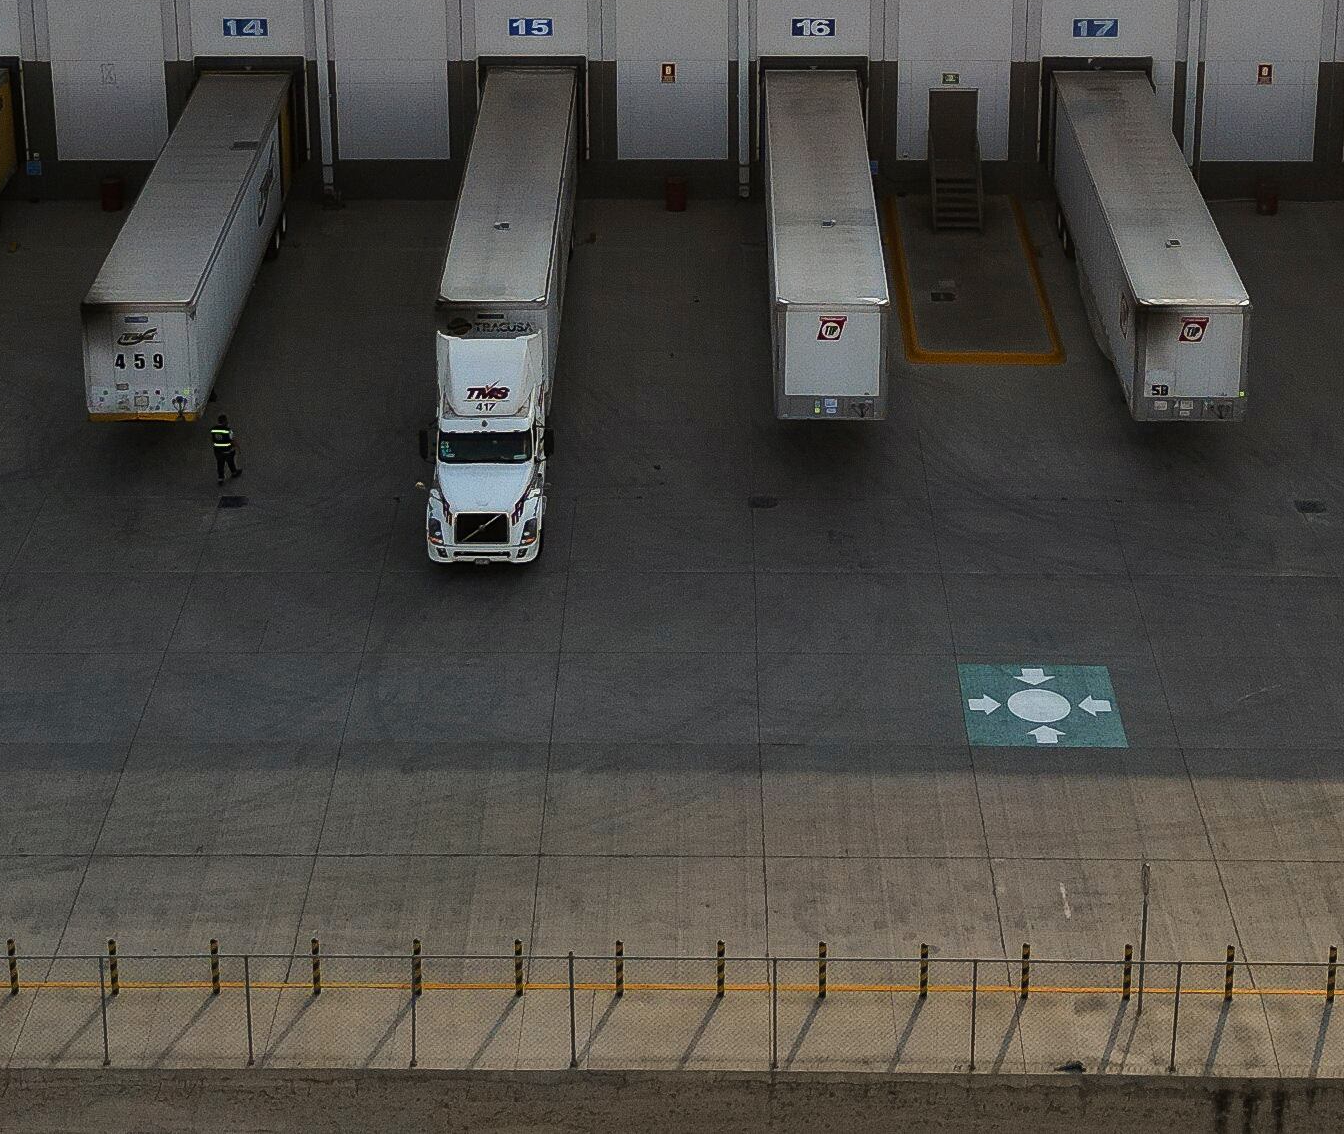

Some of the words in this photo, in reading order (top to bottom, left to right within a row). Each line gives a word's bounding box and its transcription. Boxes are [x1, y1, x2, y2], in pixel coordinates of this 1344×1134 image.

[226, 19, 264, 35] 14
[512, 19, 549, 35] 15
[796, 19, 831, 36] 16
[1077, 20, 1115, 36] 17
[475, 322, 532, 332] TRACUSA
[467, 387, 510, 400] TMS
[476, 403, 496, 412] 417
